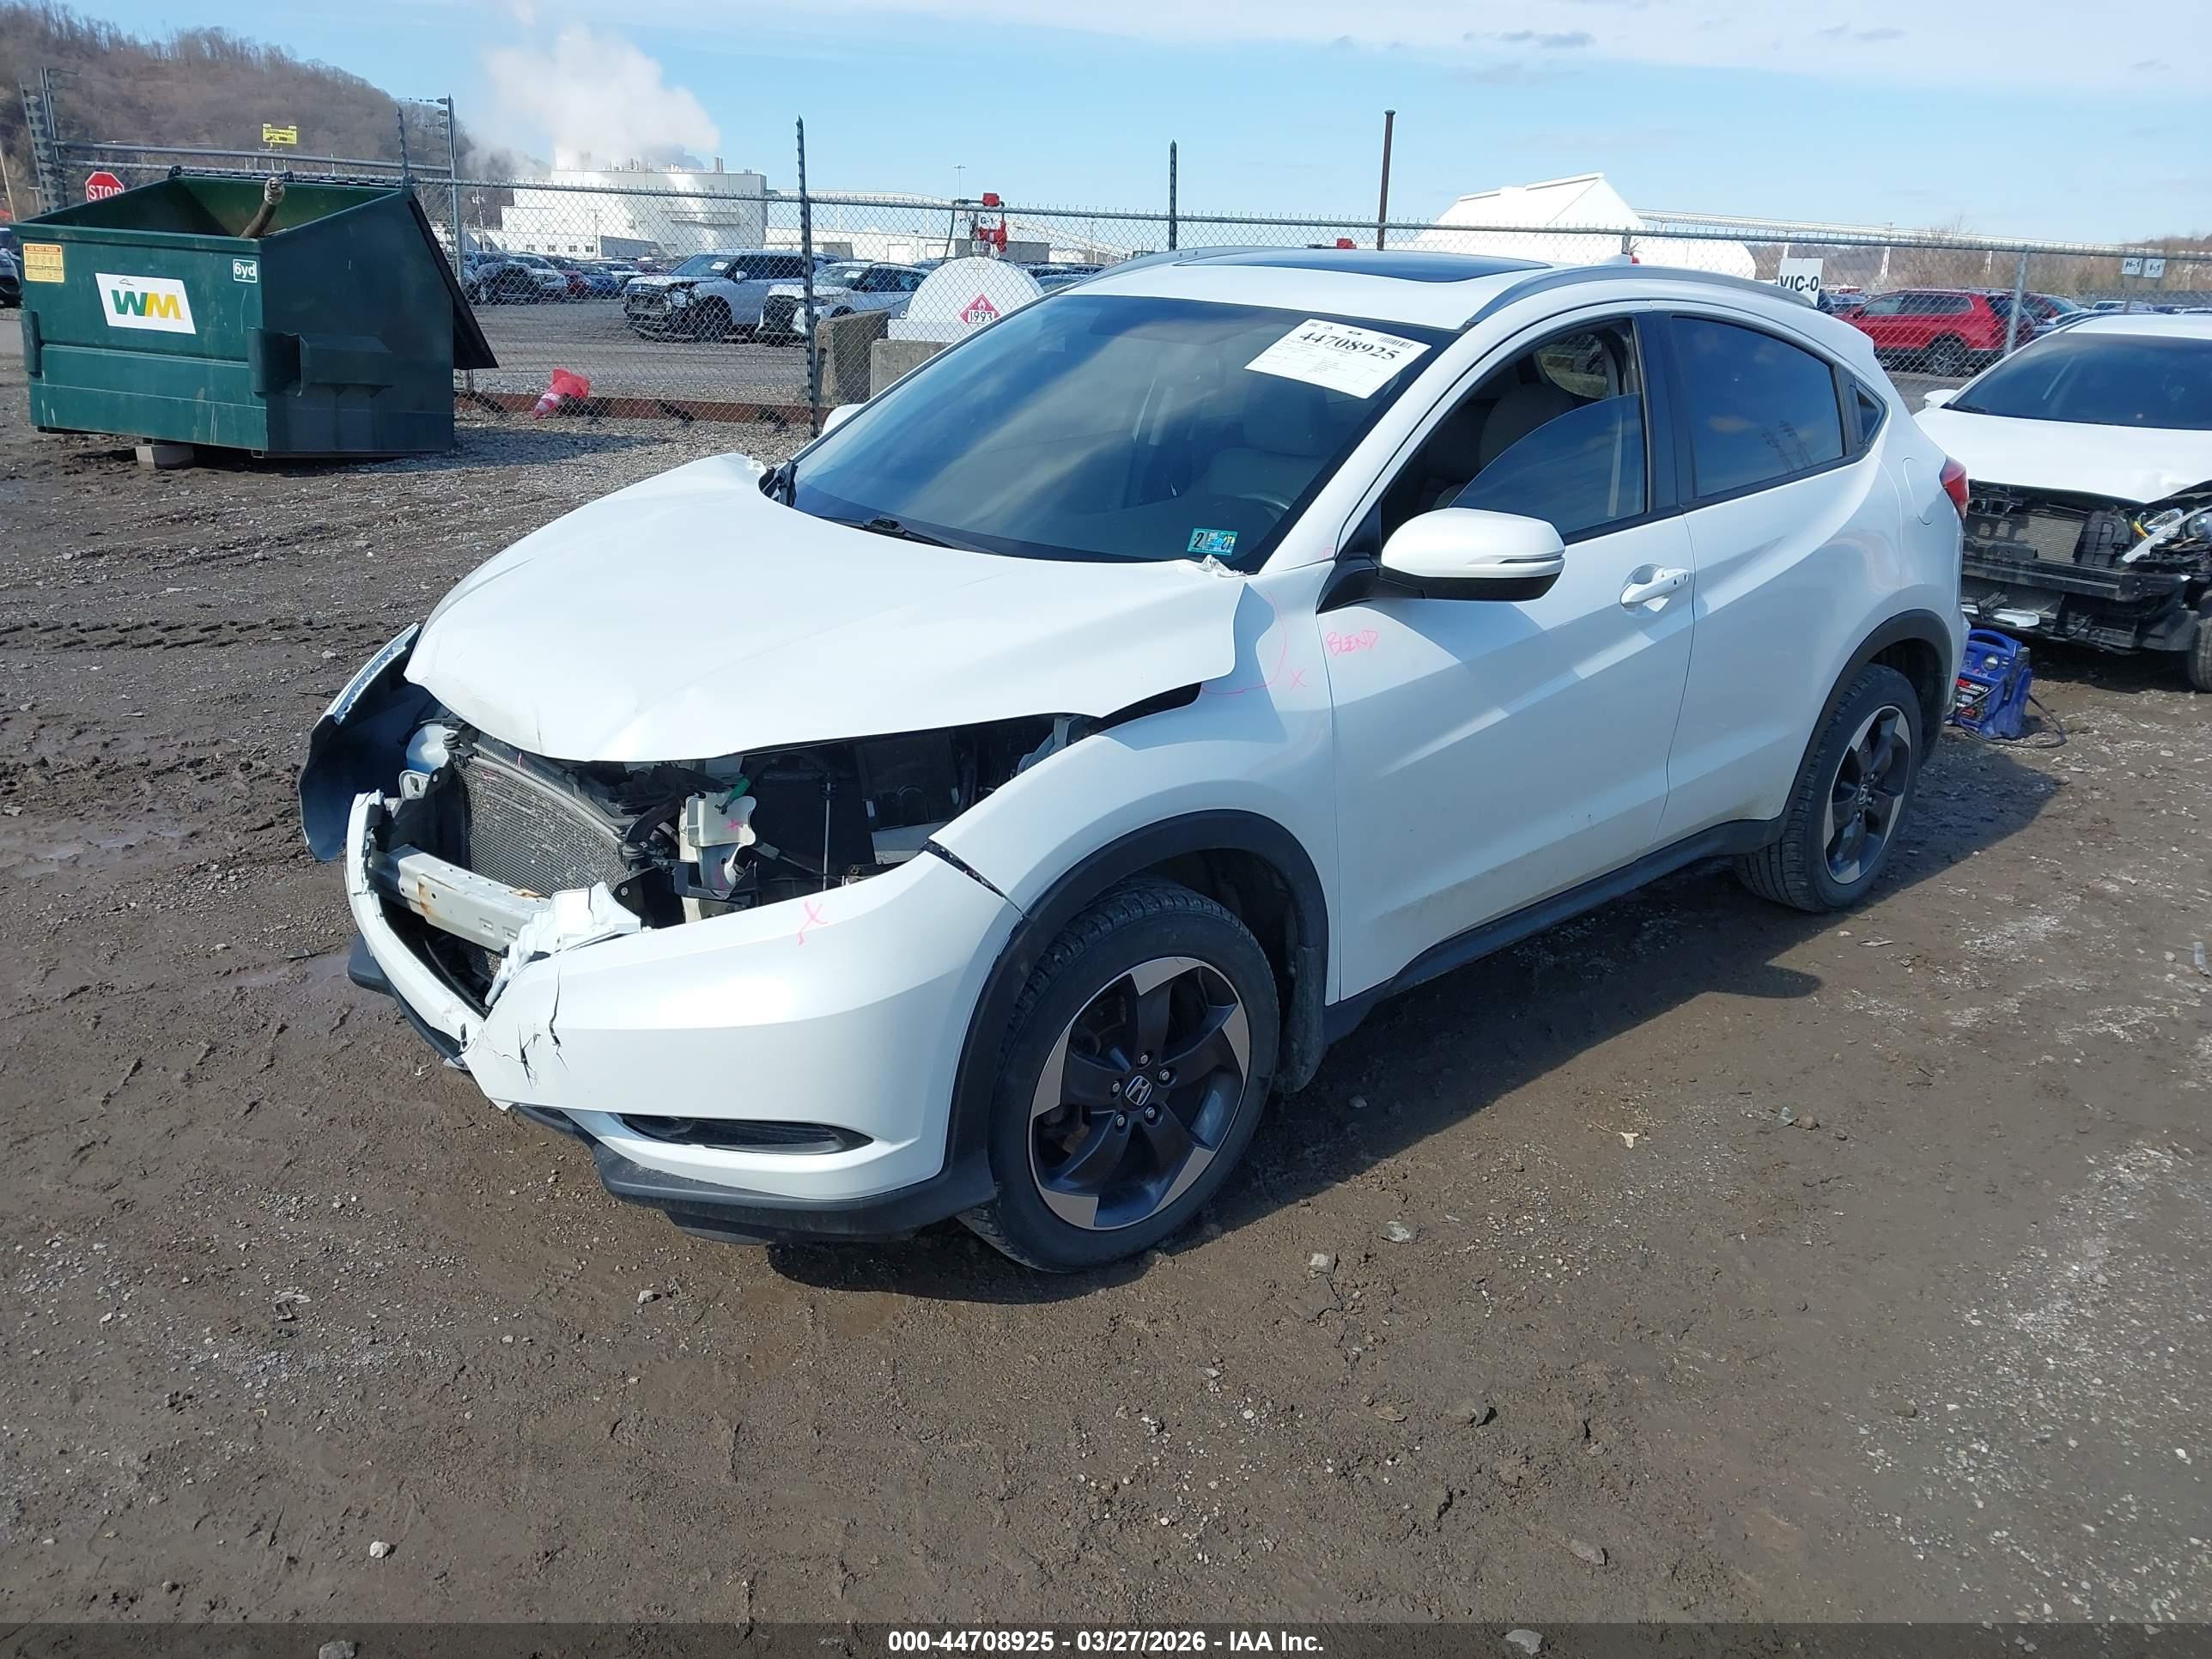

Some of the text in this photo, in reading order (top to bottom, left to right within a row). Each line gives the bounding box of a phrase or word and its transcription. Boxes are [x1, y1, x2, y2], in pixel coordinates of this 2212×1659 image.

[234, 262, 257, 278] 6yd
[111, 289, 183, 320] WM
[970, 310, 993, 322] 1993
[1299, 331, 1401, 361] 44708925
[1194, 532, 1205, 549] 2
